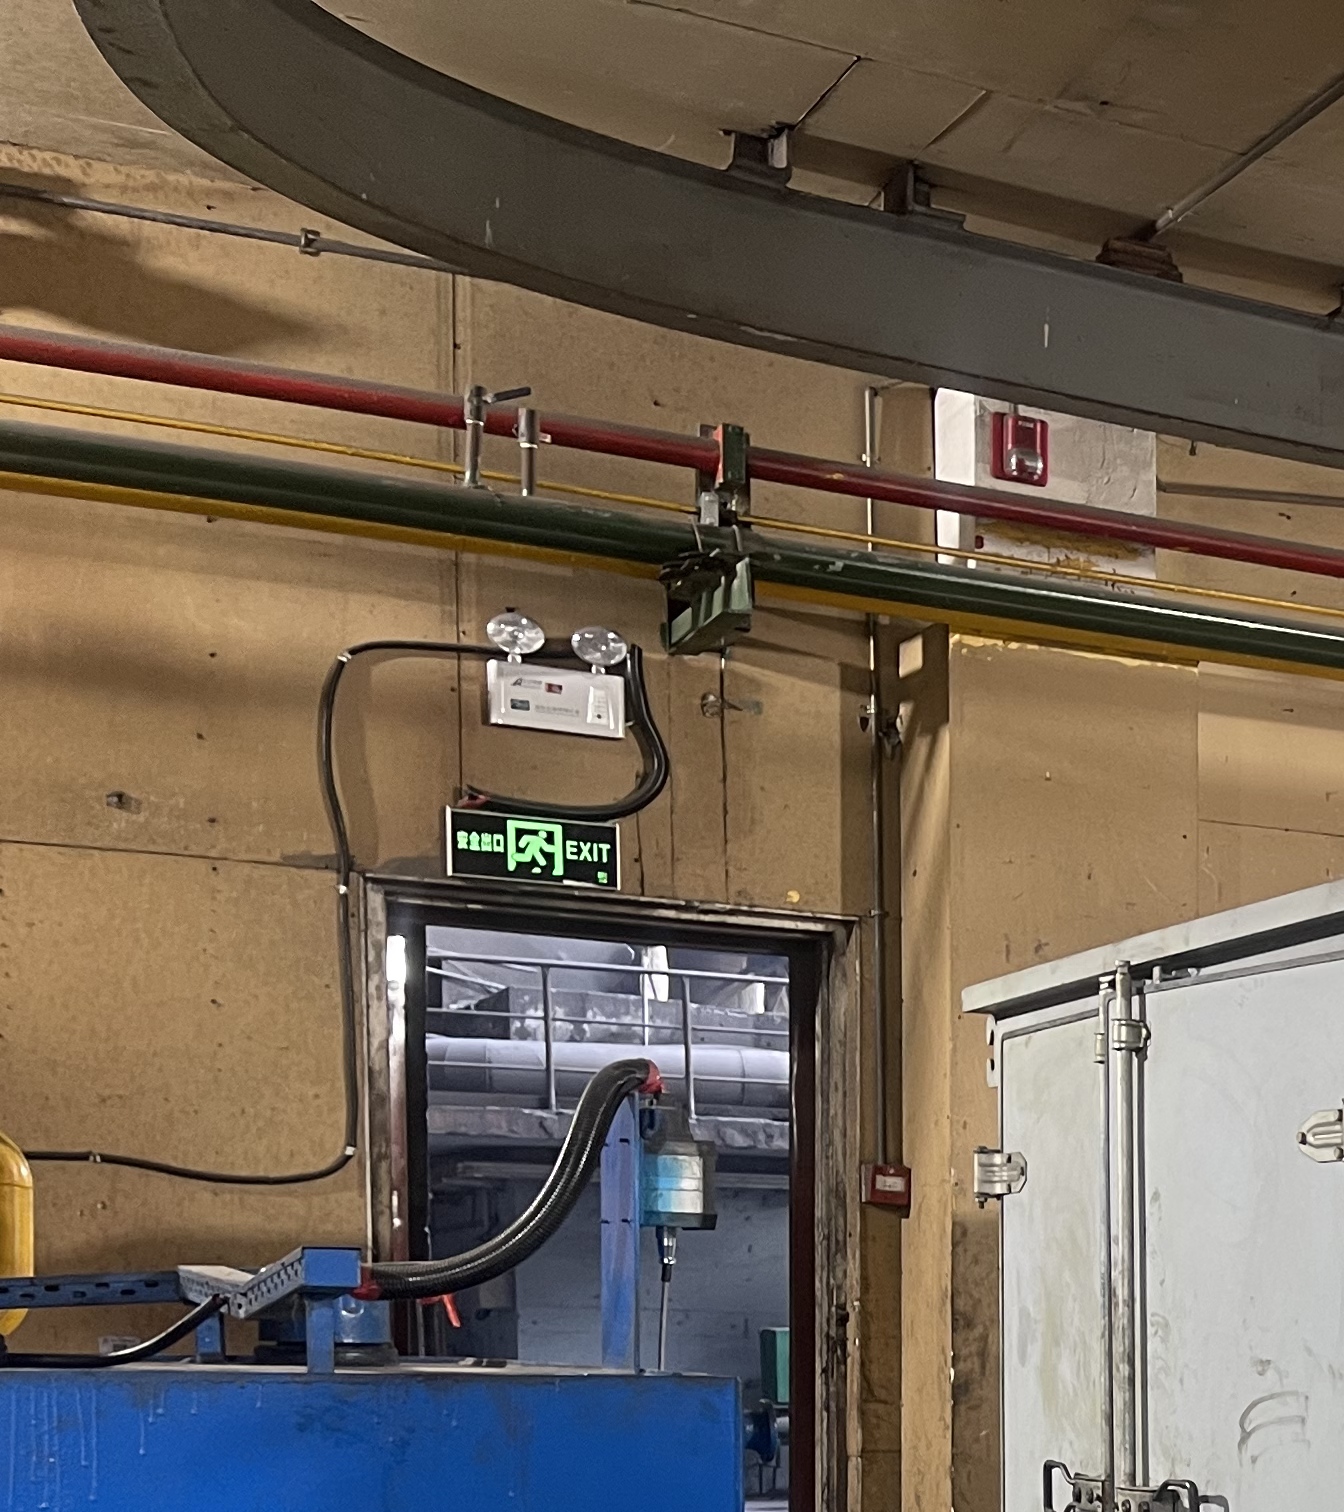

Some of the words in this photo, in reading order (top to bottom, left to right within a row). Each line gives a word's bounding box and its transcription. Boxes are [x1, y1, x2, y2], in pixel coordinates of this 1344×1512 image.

[457, 830, 504, 853] 安全出口
[565, 840, 611, 863] EXIT
